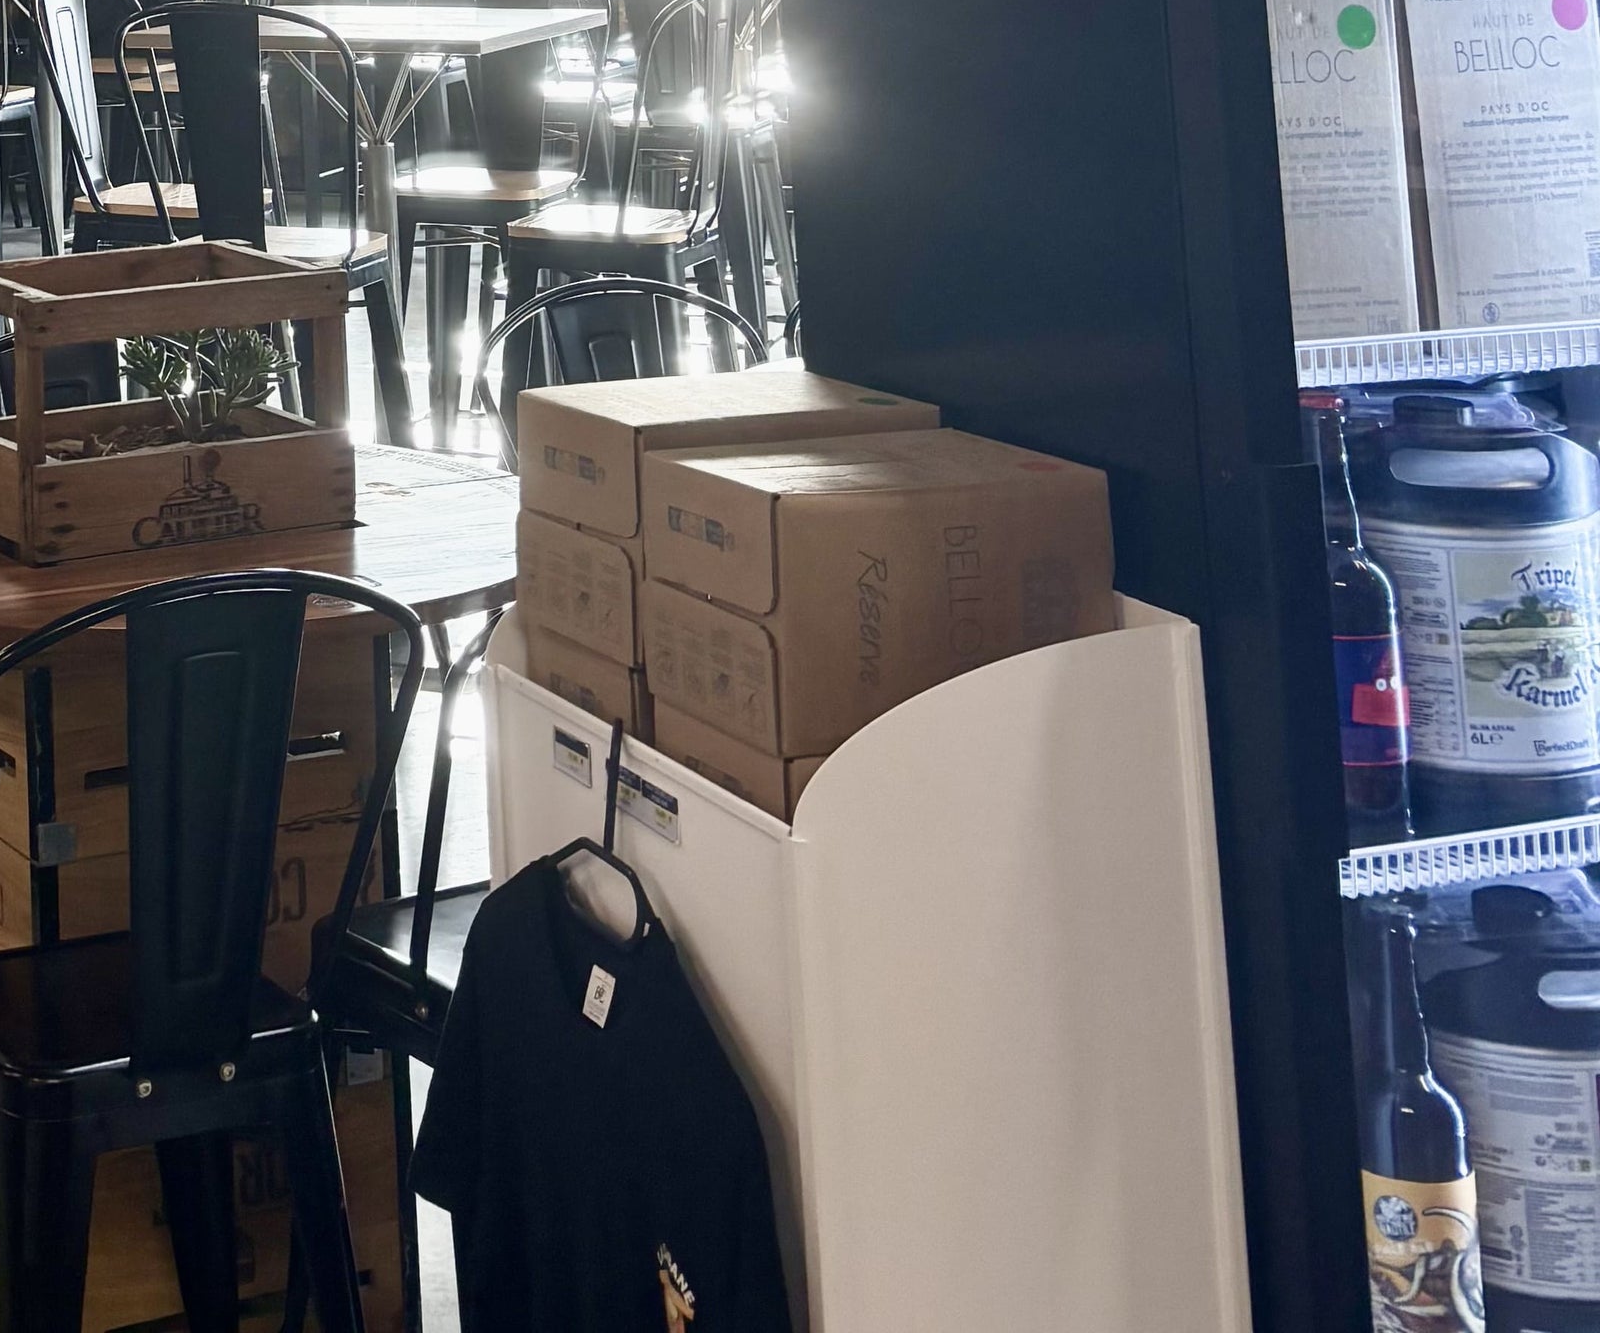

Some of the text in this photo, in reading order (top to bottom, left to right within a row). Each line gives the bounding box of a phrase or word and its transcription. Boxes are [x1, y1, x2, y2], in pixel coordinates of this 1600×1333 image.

[1473, 13, 1535, 29] HAUT DE
[1454, 35, 1560, 73] BELLOC
[1481, 102, 1511, 115] PAYS
[1511, 561, 1579, 591] Tripel
